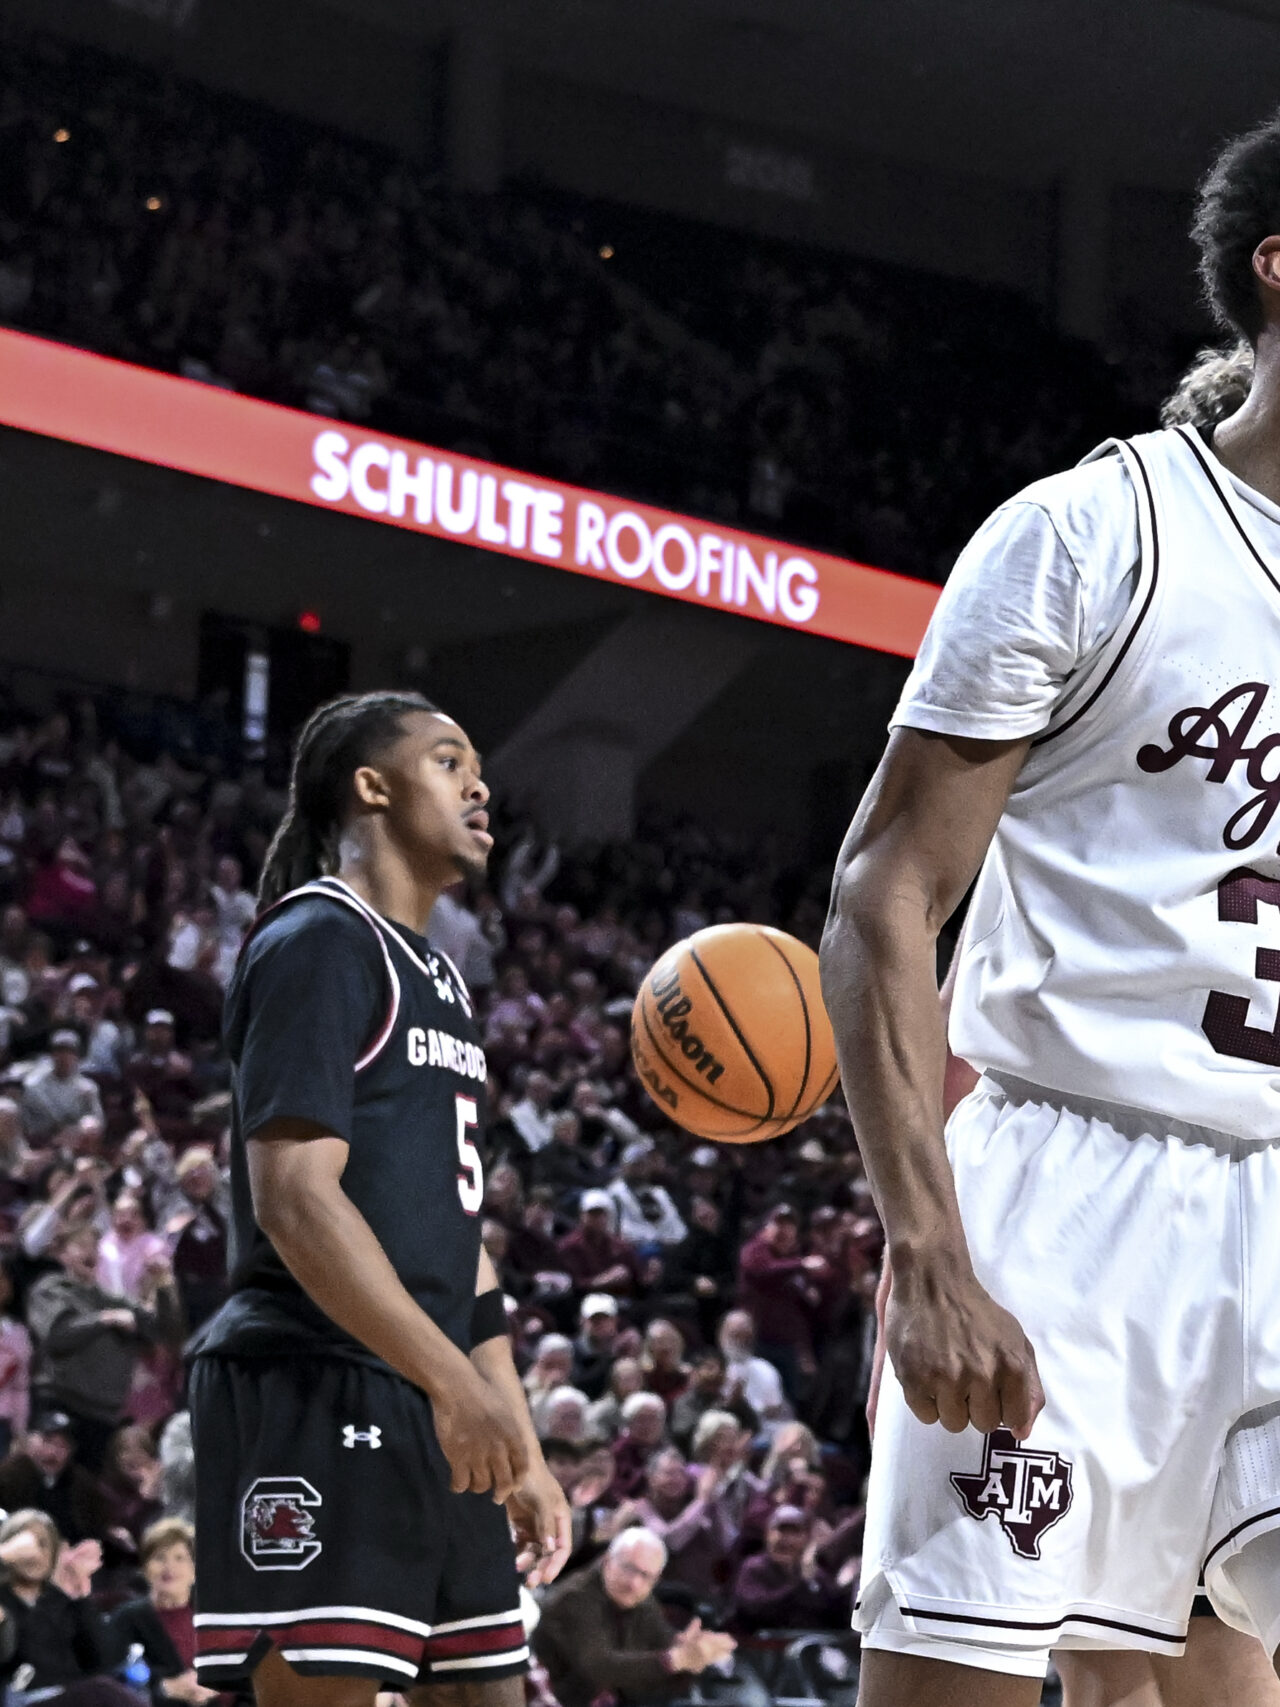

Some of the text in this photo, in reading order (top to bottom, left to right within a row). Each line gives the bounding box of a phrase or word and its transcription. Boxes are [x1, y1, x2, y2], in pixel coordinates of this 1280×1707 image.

[310, 430, 819, 622] SCHULTE ROOFING
[407, 1027, 488, 1083] GAMECOC
[455, 1092, 484, 1216] 5
